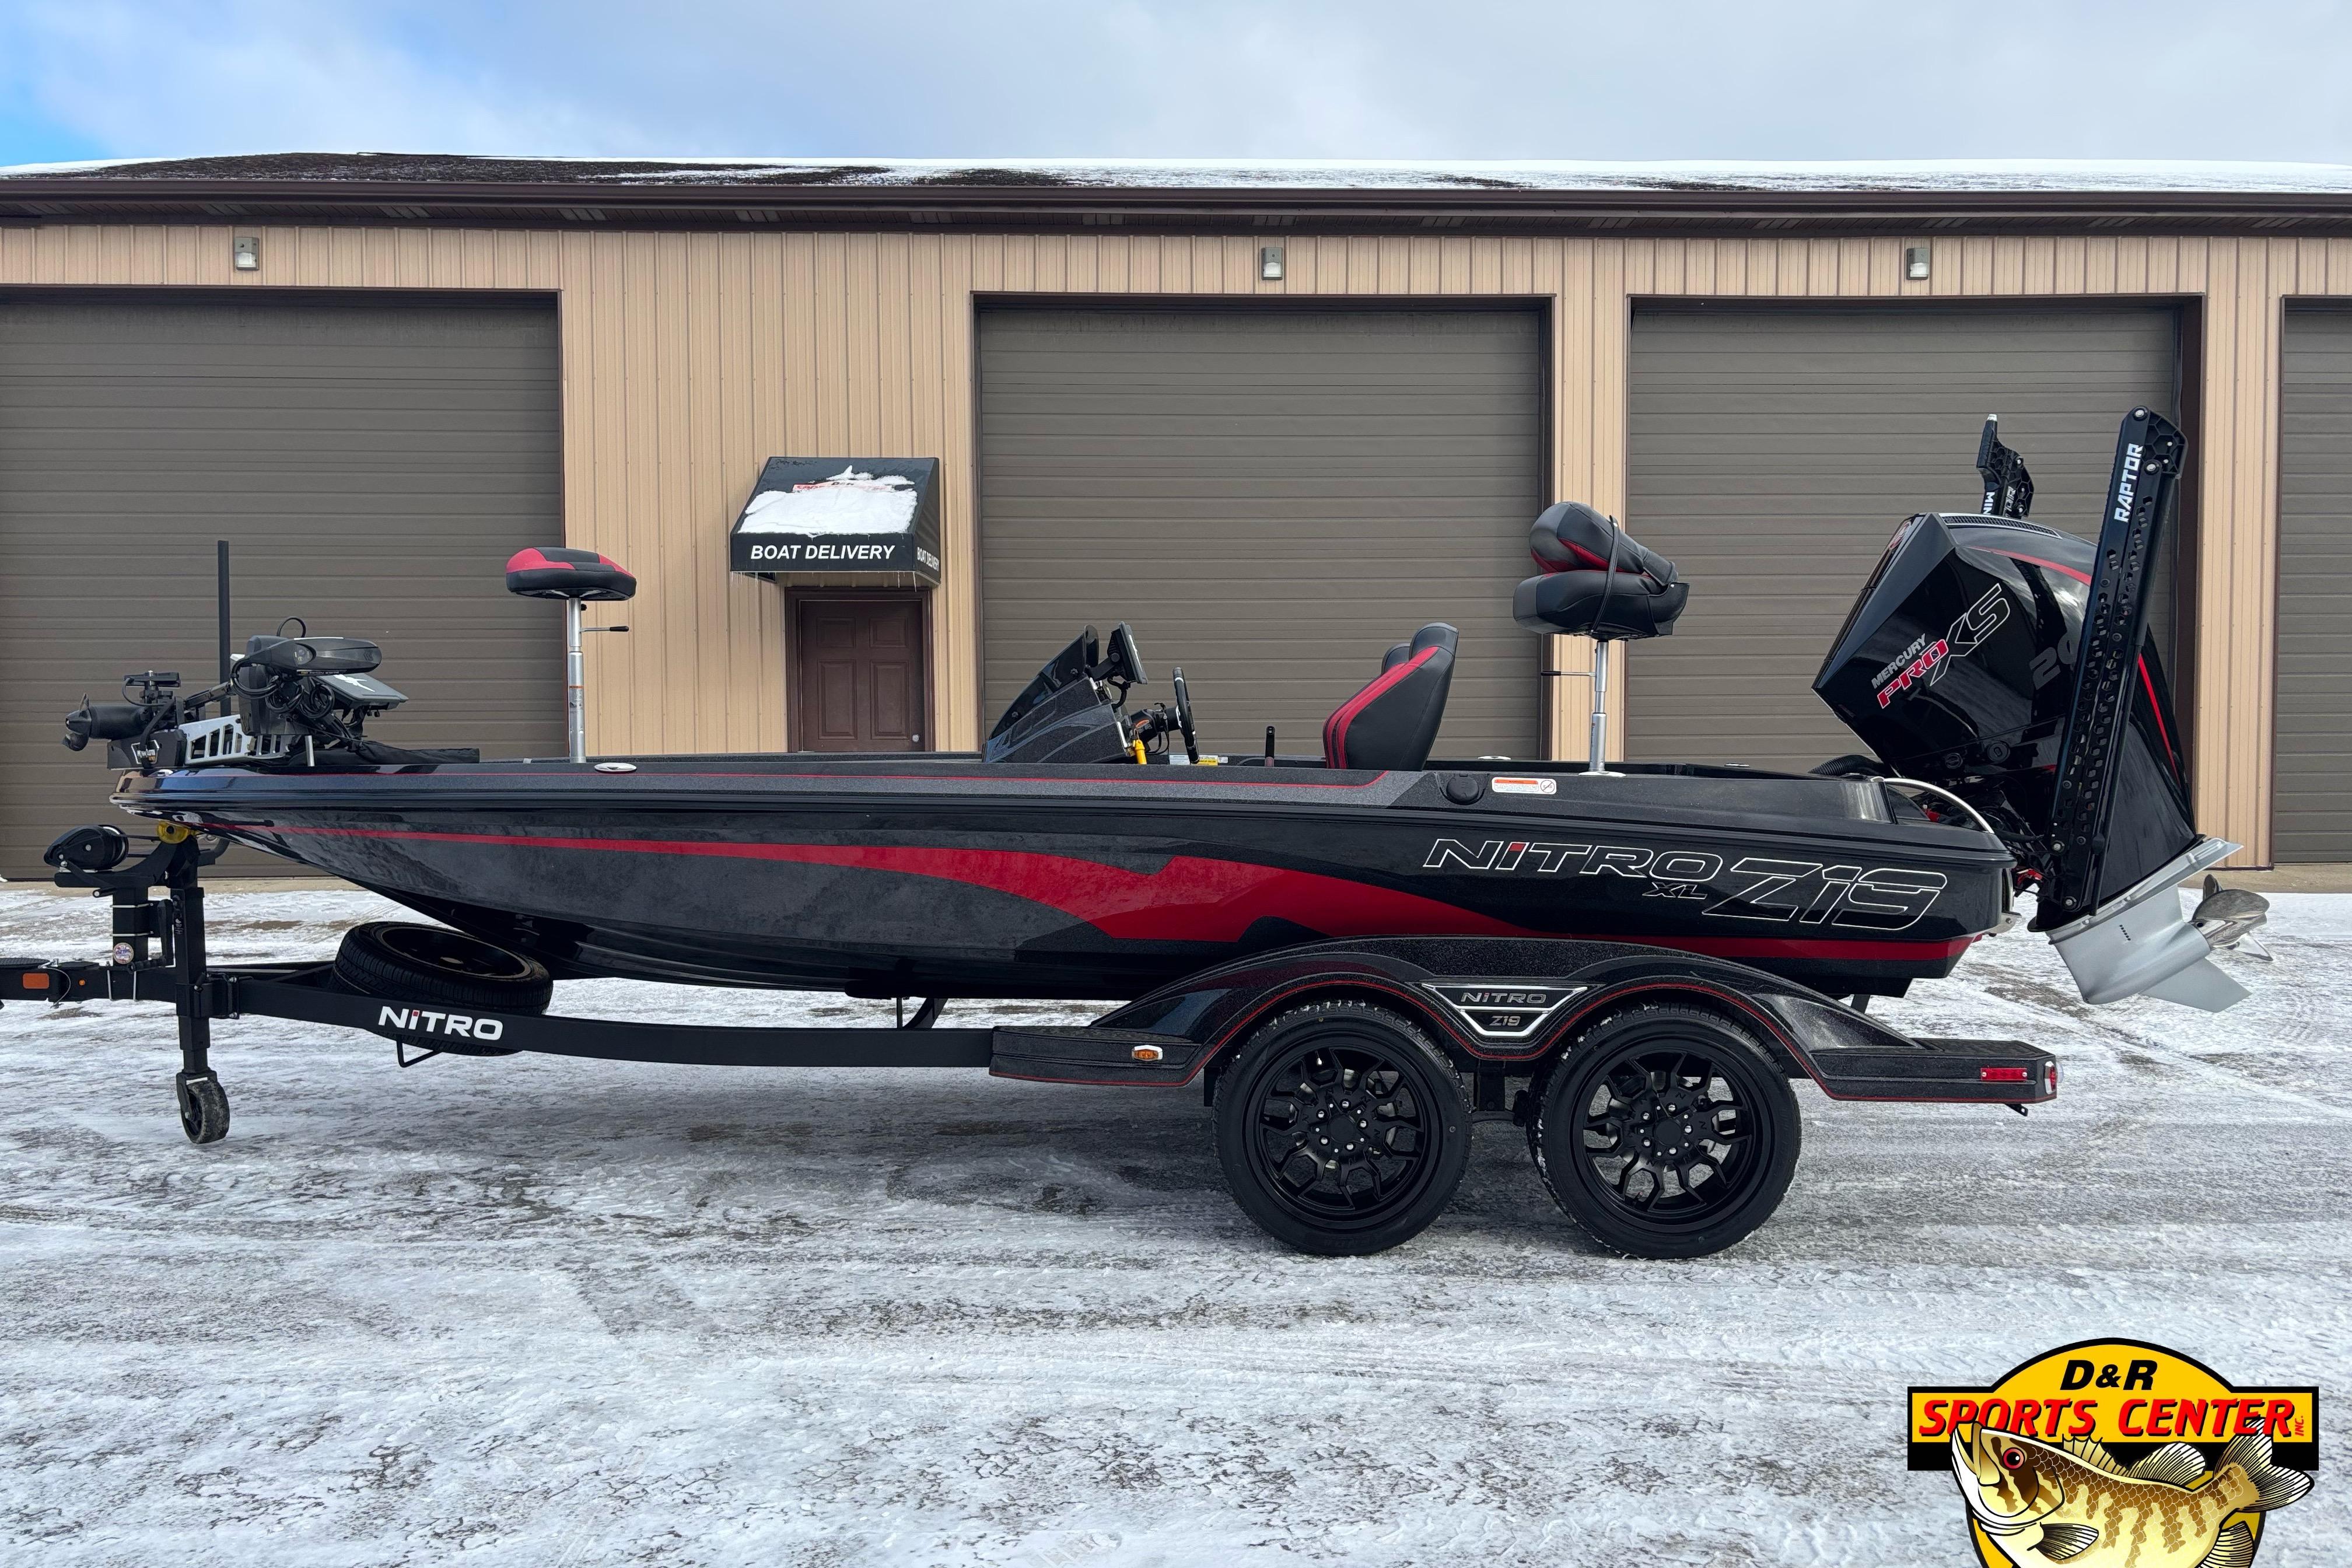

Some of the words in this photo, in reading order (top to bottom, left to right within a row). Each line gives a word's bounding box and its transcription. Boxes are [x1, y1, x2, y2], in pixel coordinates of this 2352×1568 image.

[2114, 443, 2144, 523] RAPTOR
[751, 545, 802, 559] BOAT
[805, 545, 895, 559] DELIVERY
[1871, 634, 1926, 689] MERCURY
[1642, 881, 1708, 900] XL
[1702, 857, 1947, 930] Z19
[1489, 1016, 1521, 1026] Z19
